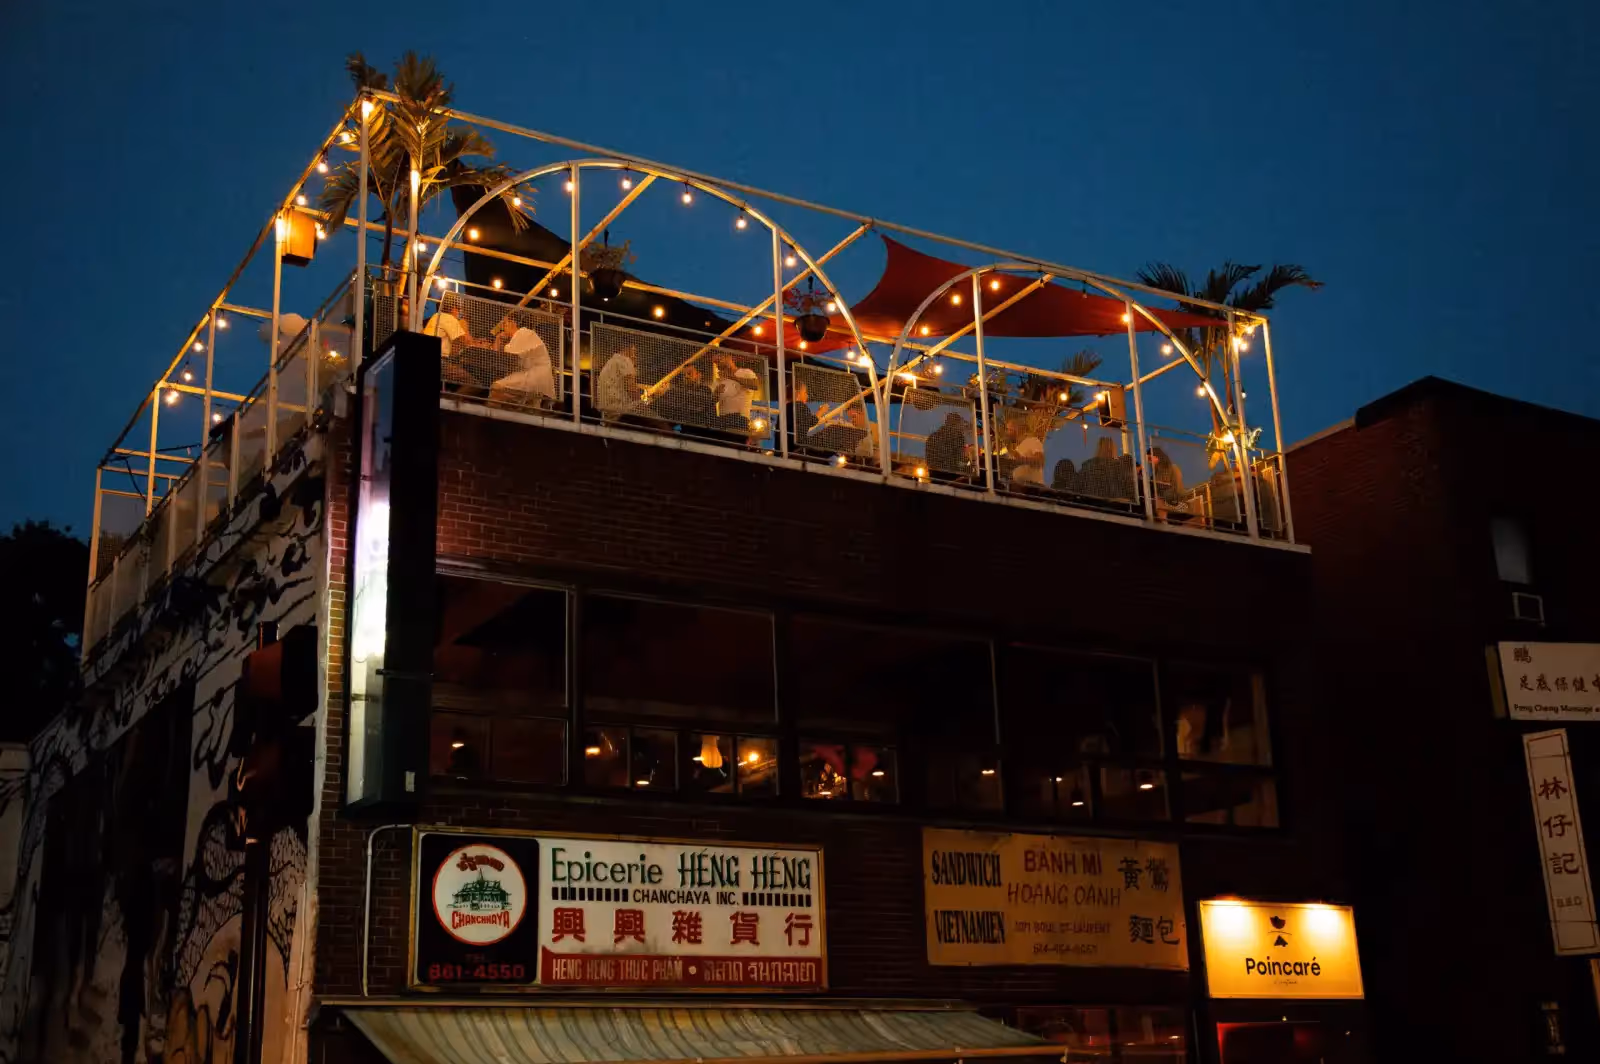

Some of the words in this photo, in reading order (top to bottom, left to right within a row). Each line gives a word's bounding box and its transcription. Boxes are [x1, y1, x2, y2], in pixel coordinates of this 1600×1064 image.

[1538, 776, 1580, 875] 林仔記
[552, 847, 663, 897] Epicerie
[931, 850, 1002, 887] SANDWICH
[633, 889, 711, 905] CHANCHAYA
[716, 891, 740, 906] INC.
[1008, 882, 1069, 905] HOANG
[1074, 883, 1121, 907] OANH
[552, 907, 813, 946] 興興雜貨行
[934, 910, 1005, 944] VIETNAMIEN
[552, 958, 583, 981] HENG
[587, 958, 616, 981] HENG
[1245, 956, 1321, 976] Poincaré
